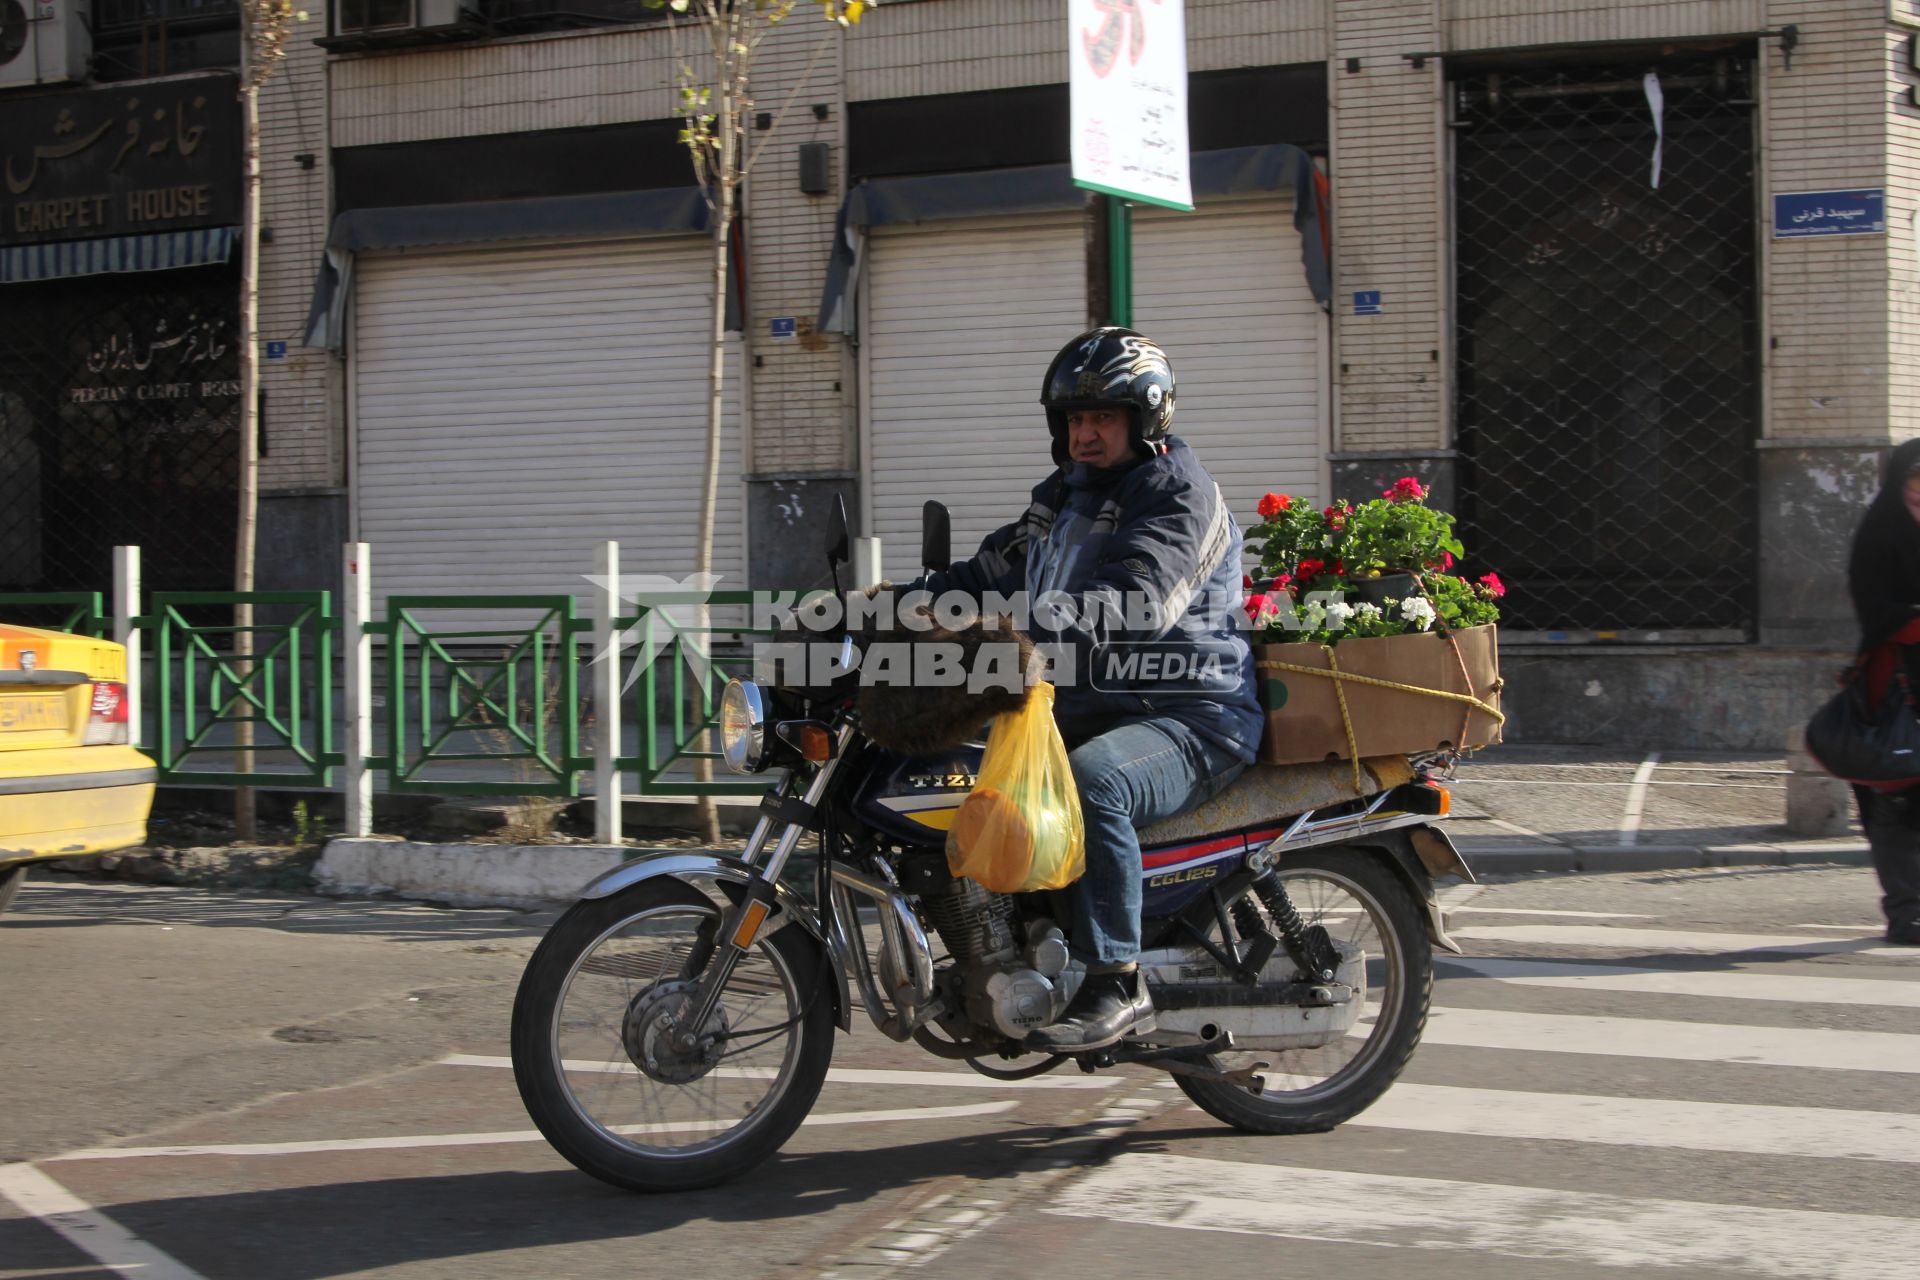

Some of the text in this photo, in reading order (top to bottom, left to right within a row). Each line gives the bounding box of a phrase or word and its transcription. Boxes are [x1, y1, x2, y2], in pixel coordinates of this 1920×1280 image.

[5, 95, 207, 194] خانه فرش
[15, 185, 209, 233] CARPET HOUSE
